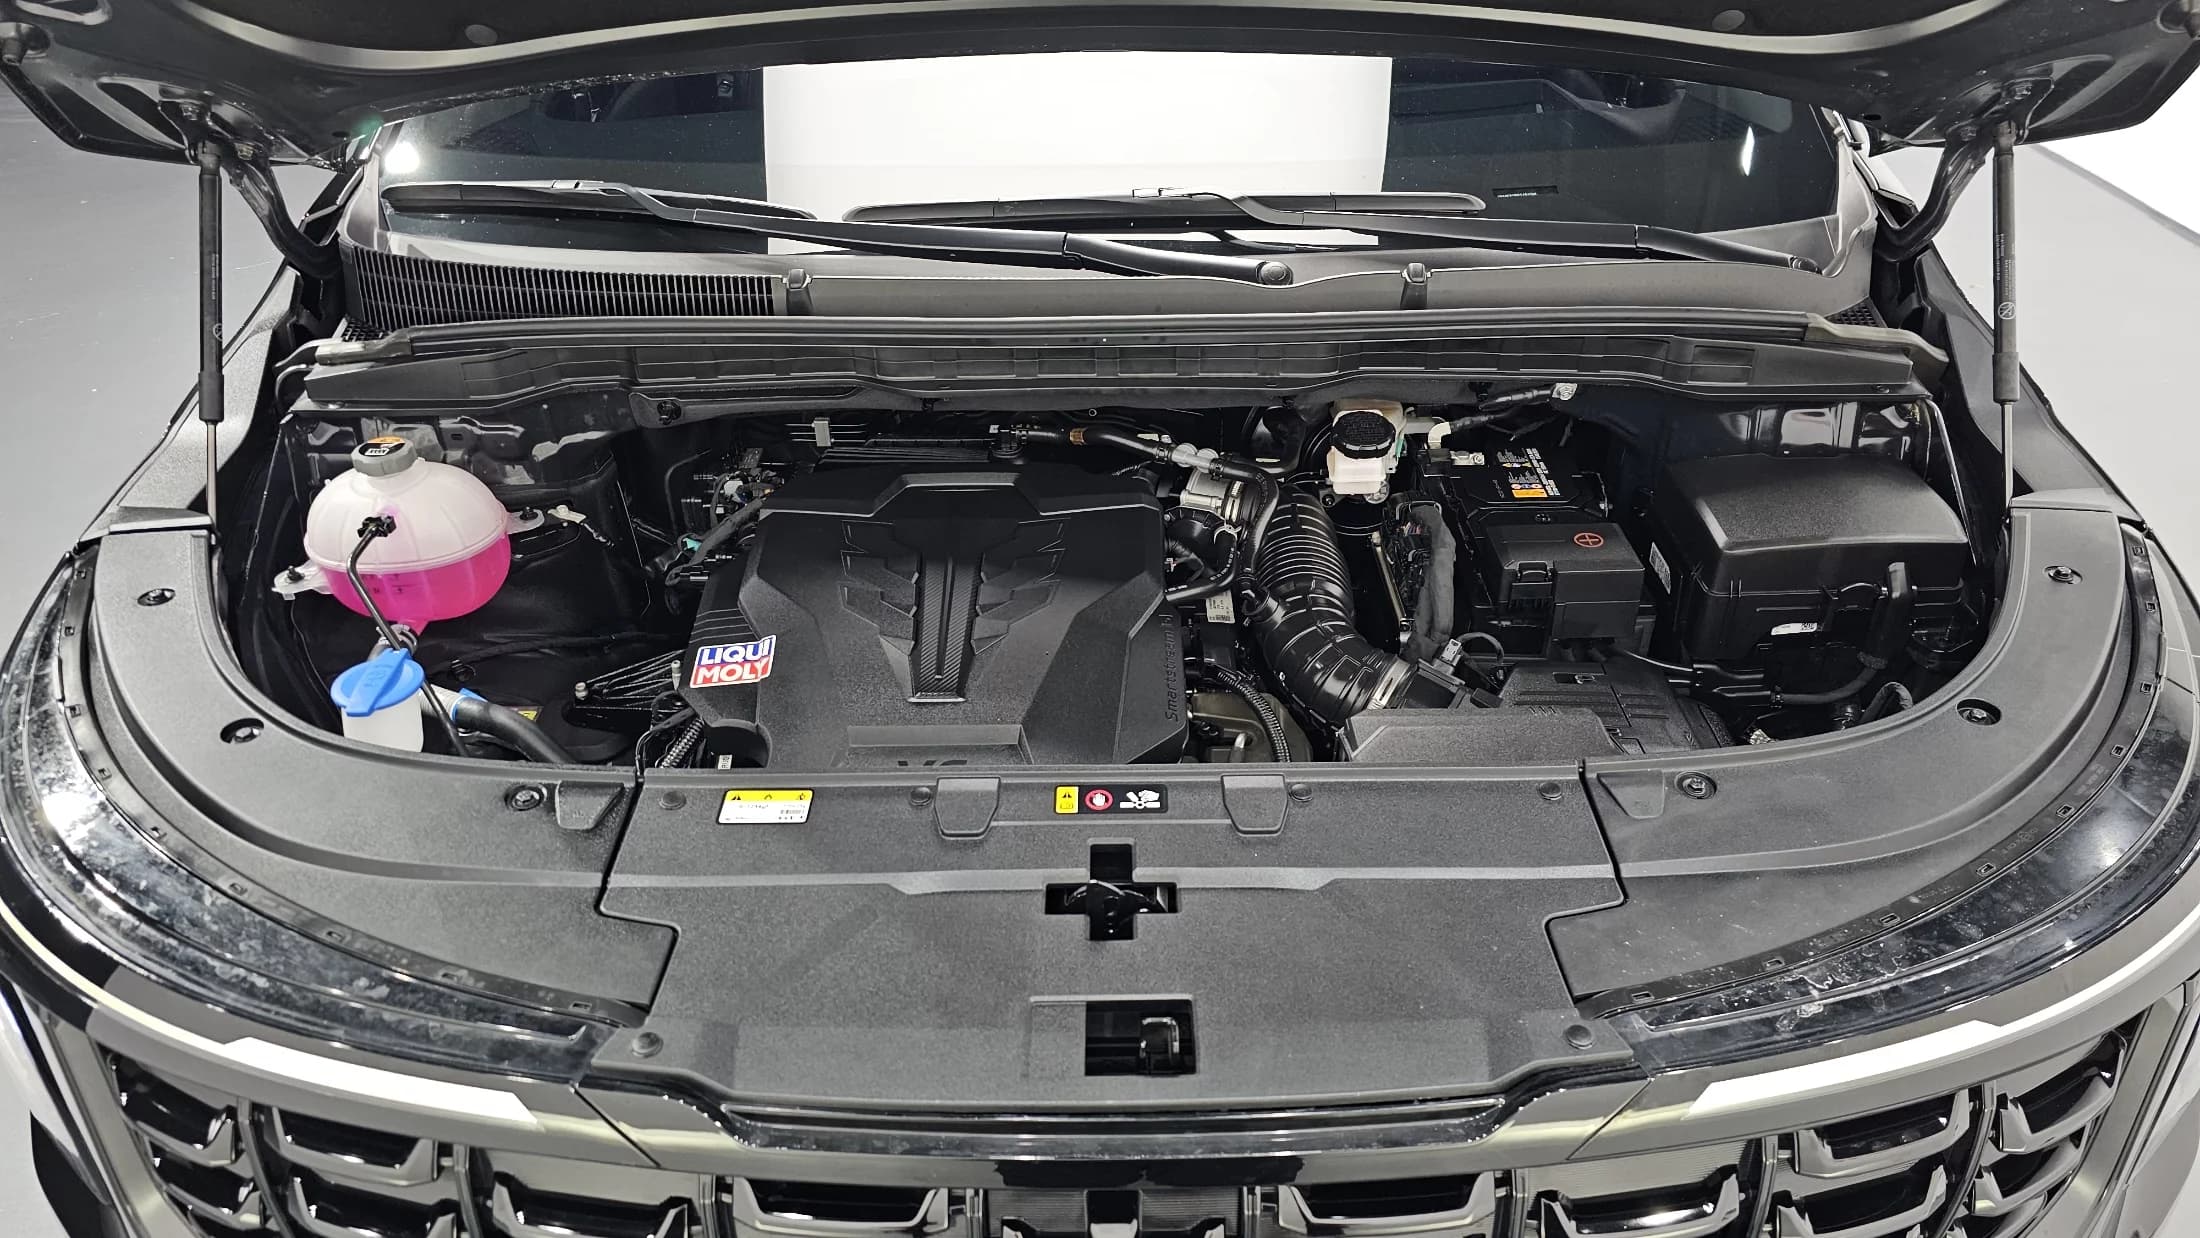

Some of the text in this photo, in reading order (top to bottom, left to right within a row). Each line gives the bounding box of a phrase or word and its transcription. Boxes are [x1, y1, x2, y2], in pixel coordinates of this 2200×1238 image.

[700, 639, 770, 665] LIQUI
[697, 656, 769, 685] MOLY
[1163, 629, 1179, 722] Smartstream
